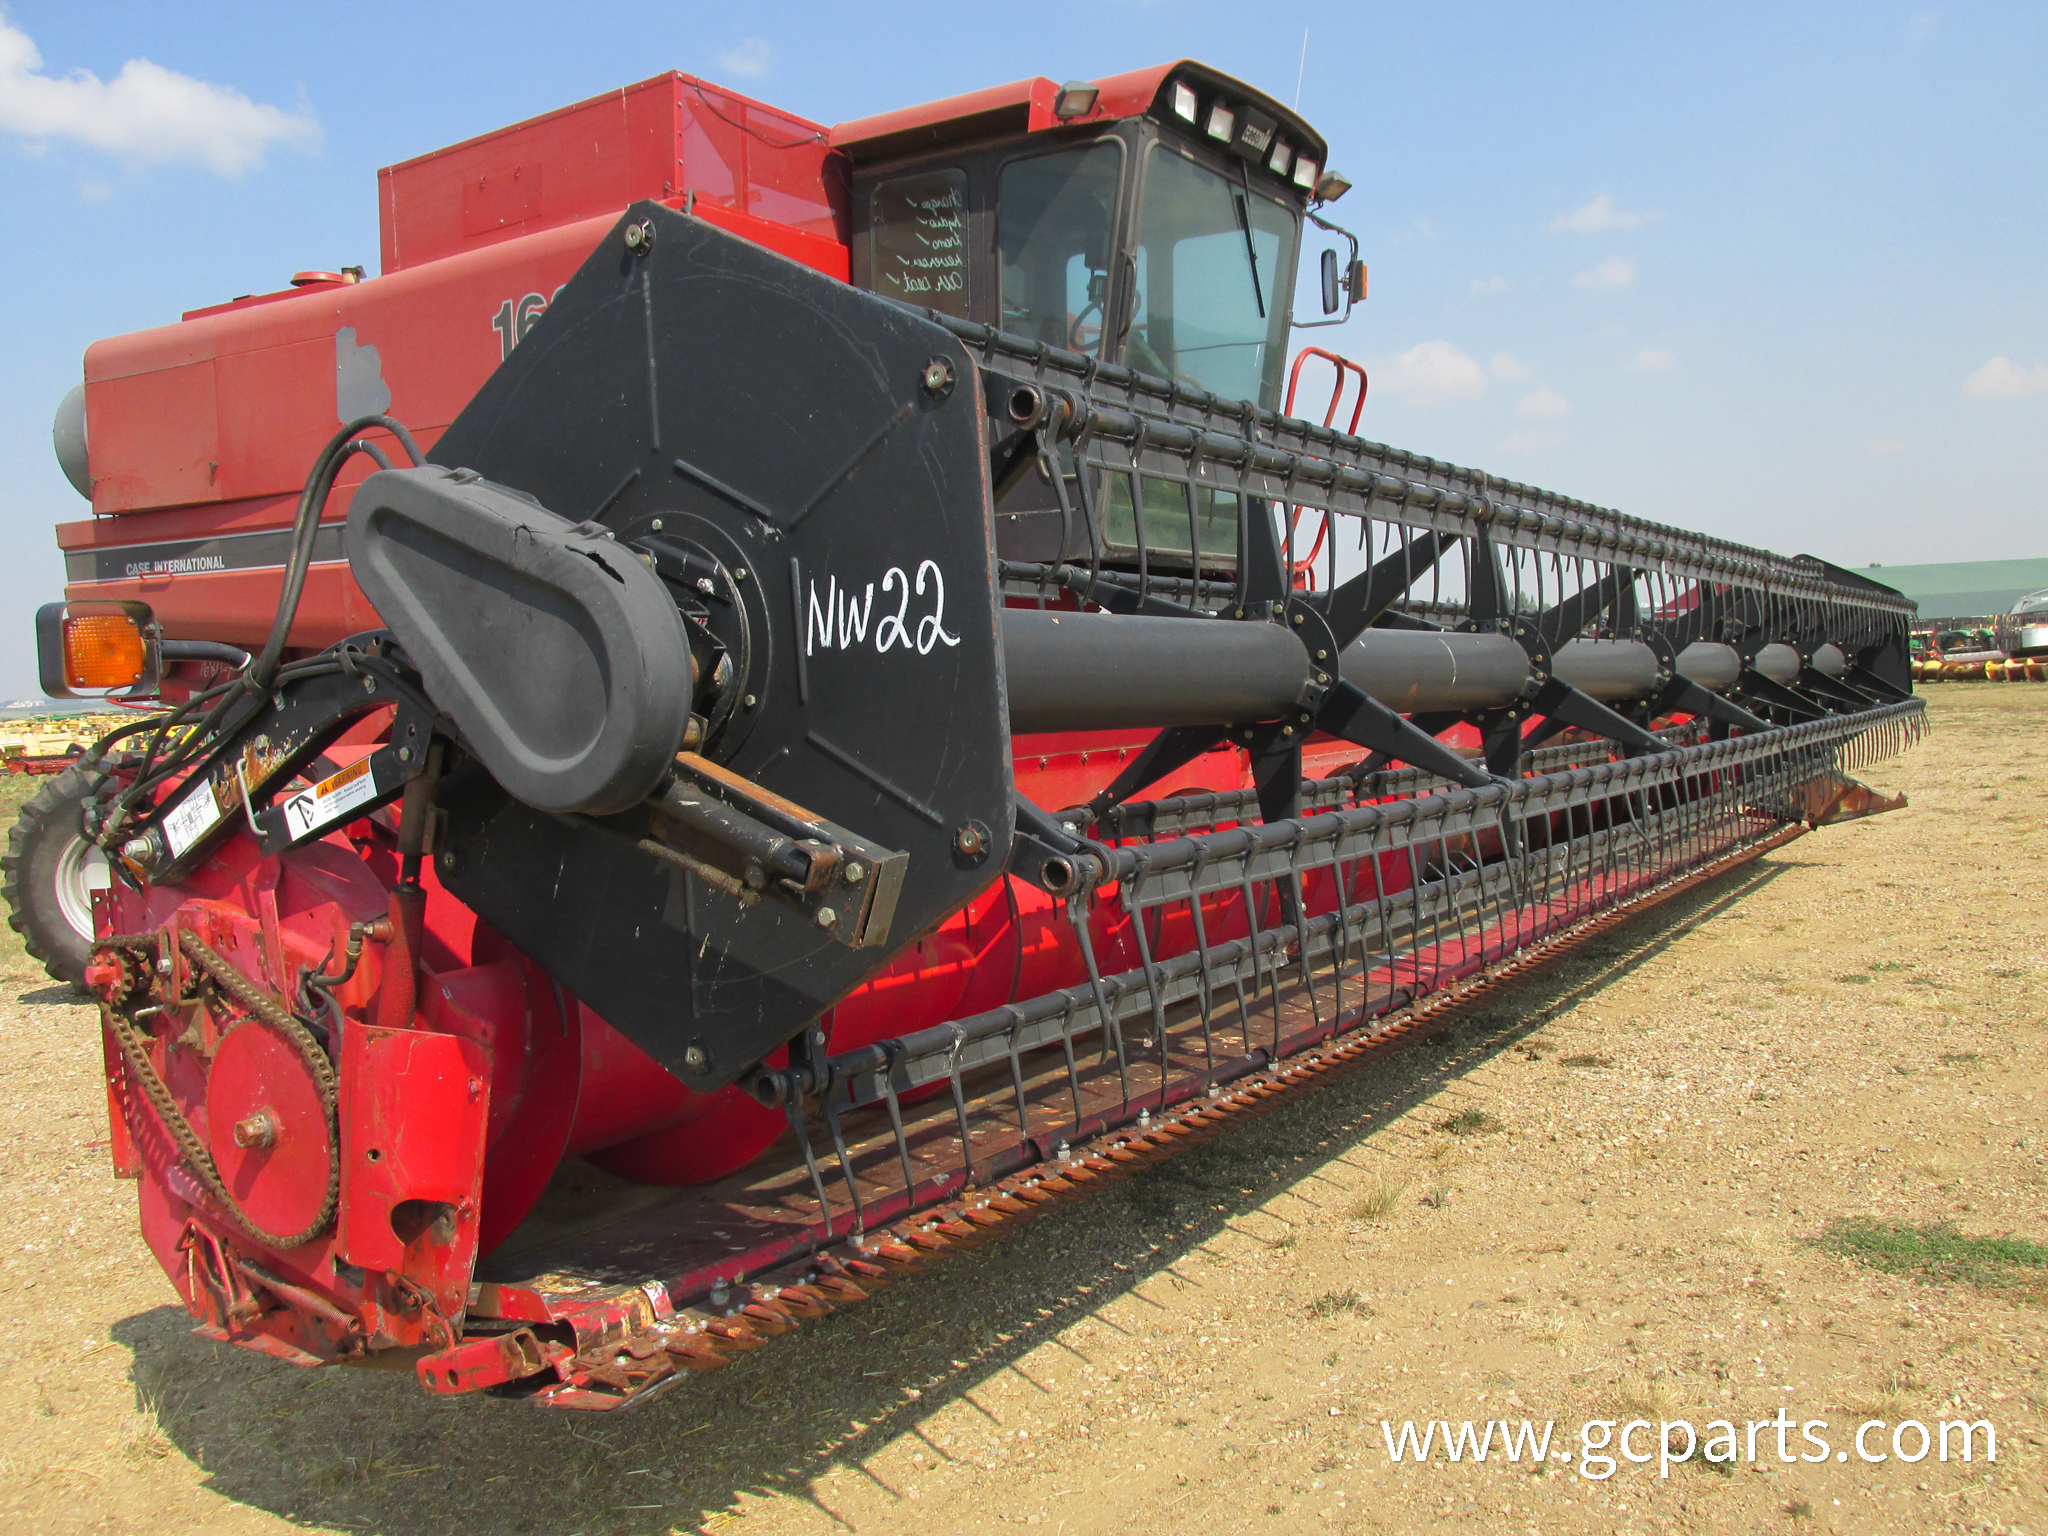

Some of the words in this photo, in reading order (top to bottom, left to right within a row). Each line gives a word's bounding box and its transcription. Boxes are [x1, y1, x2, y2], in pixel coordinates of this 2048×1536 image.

[492, 285, 566, 361] 16
[126, 562, 150, 576] CASE
[154, 556, 225, 572] INTERNATIONAL
[806, 559, 961, 656] NW22
[331, 765, 362, 789] WARNING
